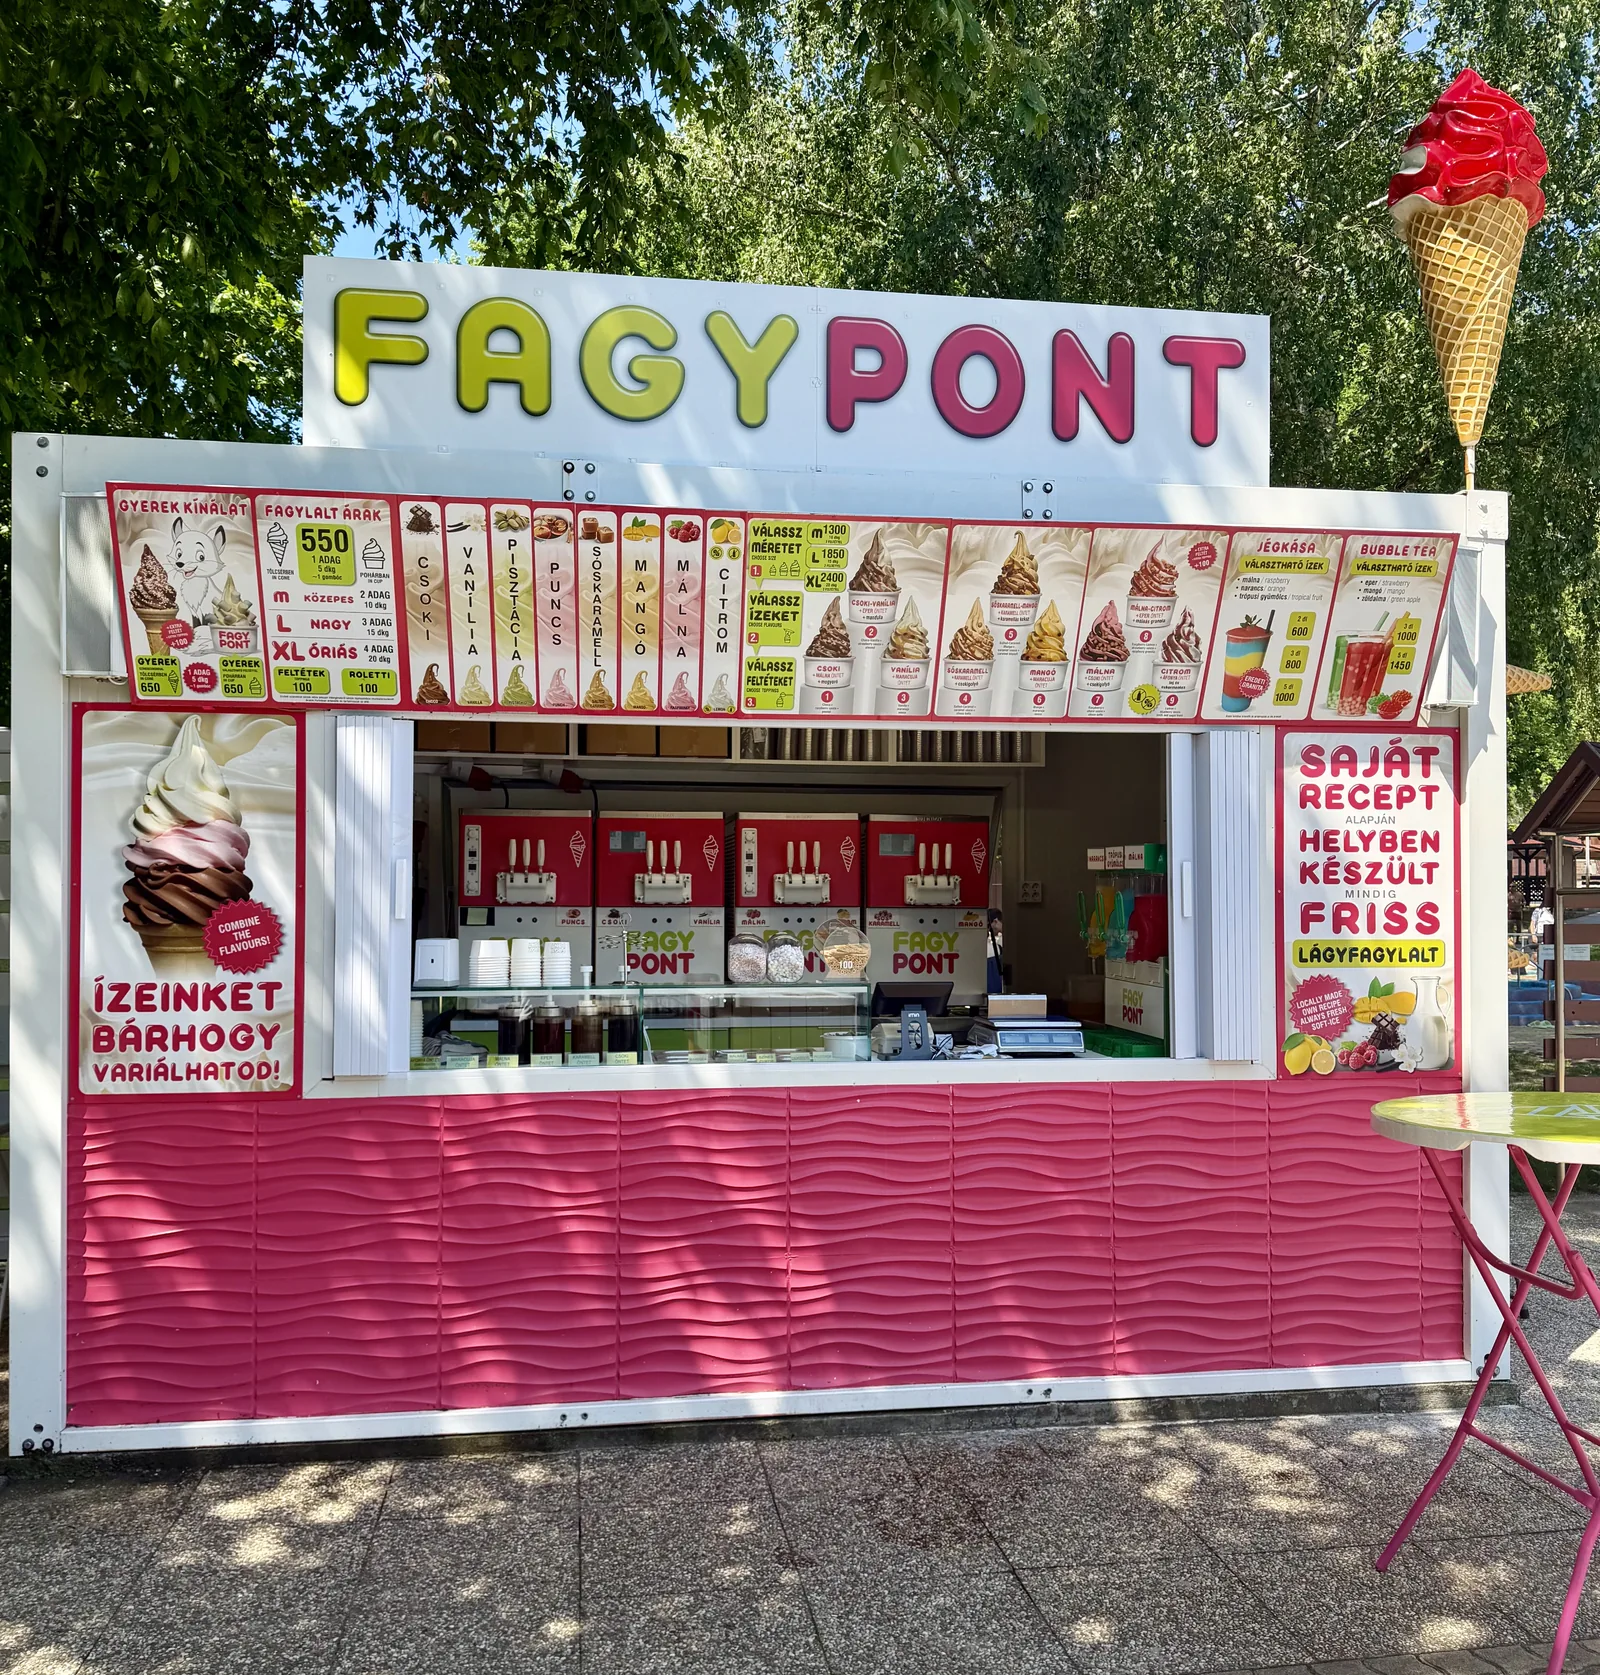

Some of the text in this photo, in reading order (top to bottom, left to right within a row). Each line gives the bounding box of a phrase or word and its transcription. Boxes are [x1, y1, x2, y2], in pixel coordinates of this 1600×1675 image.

[334, 287, 1246, 448] FAGYPONT
[119, 497, 248, 517] GYEREK KÍNÁLAT
[265, 504, 381, 522] FAGYLALT ÁRAK
[752, 522, 803, 538] VÁLASSZ
[823, 524, 846, 535] 1300
[301, 528, 349, 553] 550
[751, 539, 802, 554] MÉRETET
[1257, 538, 1316, 553] JÉGKÁSA
[812, 549, 844, 563] L 1850
[1361, 544, 1436, 557] BUBBLE TEA
[312, 555, 341, 564] 1 ADAG
[1245, 559, 1324, 570] VÁLASZTHATÓ ÍZEK
[324, 565, 336, 573] dkg
[753, 566, 760, 575] 1.
[1356, 561, 1432, 572] VÁLASZTHATÓ ÍZEK
[805, 573, 844, 588] XL 2400
[304, 592, 354, 604] KÖZEPES
[368, 591, 390, 599] ADAG
[418, 556, 432, 641] CSOKI
[463, 546, 478, 656] VANÍLIA
[507, 539, 522, 661] PISZTÁCIA
[750, 592, 800, 606] VÁLASSZ
[1239, 593, 1259, 601] trópusi
[374, 602, 387, 610] dkg
[550, 562, 562, 646] PUNCS
[592, 546, 603, 667] SÓSKARAMELL
[634, 559, 647, 656] MANGÓ
[676, 559, 690, 658] MÁLNA
[851, 599, 896, 607] CSOKI-VANÍLIA
[1130, 603, 1171, 611] MÁLNA-CITROM
[716, 568, 730, 653] CITROM
[749, 607, 799, 621] ÍZEKET
[277, 614, 351, 632] L NAGY
[362, 618, 392, 627] 3 ADAG
[218, 631, 250, 640] FAGY
[377, 629, 389, 637] dkg
[1291, 627, 1308, 636] 600
[1397, 631, 1417, 641] 1000
[220, 640, 250, 649] PONT
[272, 640, 358, 661] XL ÓRIÁS
[371, 645, 394, 653] ADAG
[138, 658, 177, 666] GYEREK
[222, 660, 260, 668] GYEREK
[378, 656, 391, 664] dkg
[747, 658, 793, 672] VÁLASSZ
[1286, 659, 1301, 669] 800
[1390, 661, 1411, 670] 1450
[278, 667, 325, 677] FELTÉTEK
[349, 671, 390, 679] ROLETTI
[891, 665, 920, 673] VANÍLIA
[947, 666, 988, 674] SÓSKARAMELL
[1029, 667, 1056, 676] MANGÓ
[1086, 667, 1115, 675] MÁLNA
[746, 674, 793, 687] FELTÉTEKET
[1244, 675, 1266, 683] EREDETI
[141, 683, 160, 692] 650
[224, 684, 243, 694] 650
[293, 682, 312, 692] 100
[359, 683, 378, 693] 100
[1275, 692, 1295, 702] 1000
[1300, 737, 1440, 779] SAJÁT
[1300, 783, 1440, 810] RECEPT
[1345, 814, 1396, 825] ALAPJÁN
[1300, 829, 1440, 853] HELYBEN
[1128, 851, 1144, 860] MÁLNA
[1300, 855, 1440, 885] KÉSZÜLT
[1345, 890, 1396, 898] MINDIG
[741, 917, 766, 926] MÁLNA
[958, 919, 984, 928] MANGÓ
[1300, 901, 1440, 935] FRISS
[218, 916, 261, 934] COMBINE
[232, 930, 251, 941] THE
[892, 931, 959, 953] FAGY
[219, 936, 271, 956] FLAVOURS!
[1298, 944, 1439, 963] LÁGYFAGYLALT
[626, 953, 695, 975] PONT
[838, 961, 853, 969] 100
[892, 952, 960, 975] PONT
[94, 975, 283, 1013] ÍZEINKET
[1122, 988, 1143, 1007] FAGY
[1296, 990, 1343, 1009] LOCALLY MADE
[1302, 999, 1341, 1016] OWN RECIPE
[1122, 1004, 1143, 1026] PONT
[1300, 1006, 1347, 1026] ALWAYS FRESH
[1311, 1018, 1340, 1031] SOFT-ICE
[93, 1017, 281, 1053] BÁRHOGY
[93, 1056, 280, 1082] VARIÁLHATOD!
